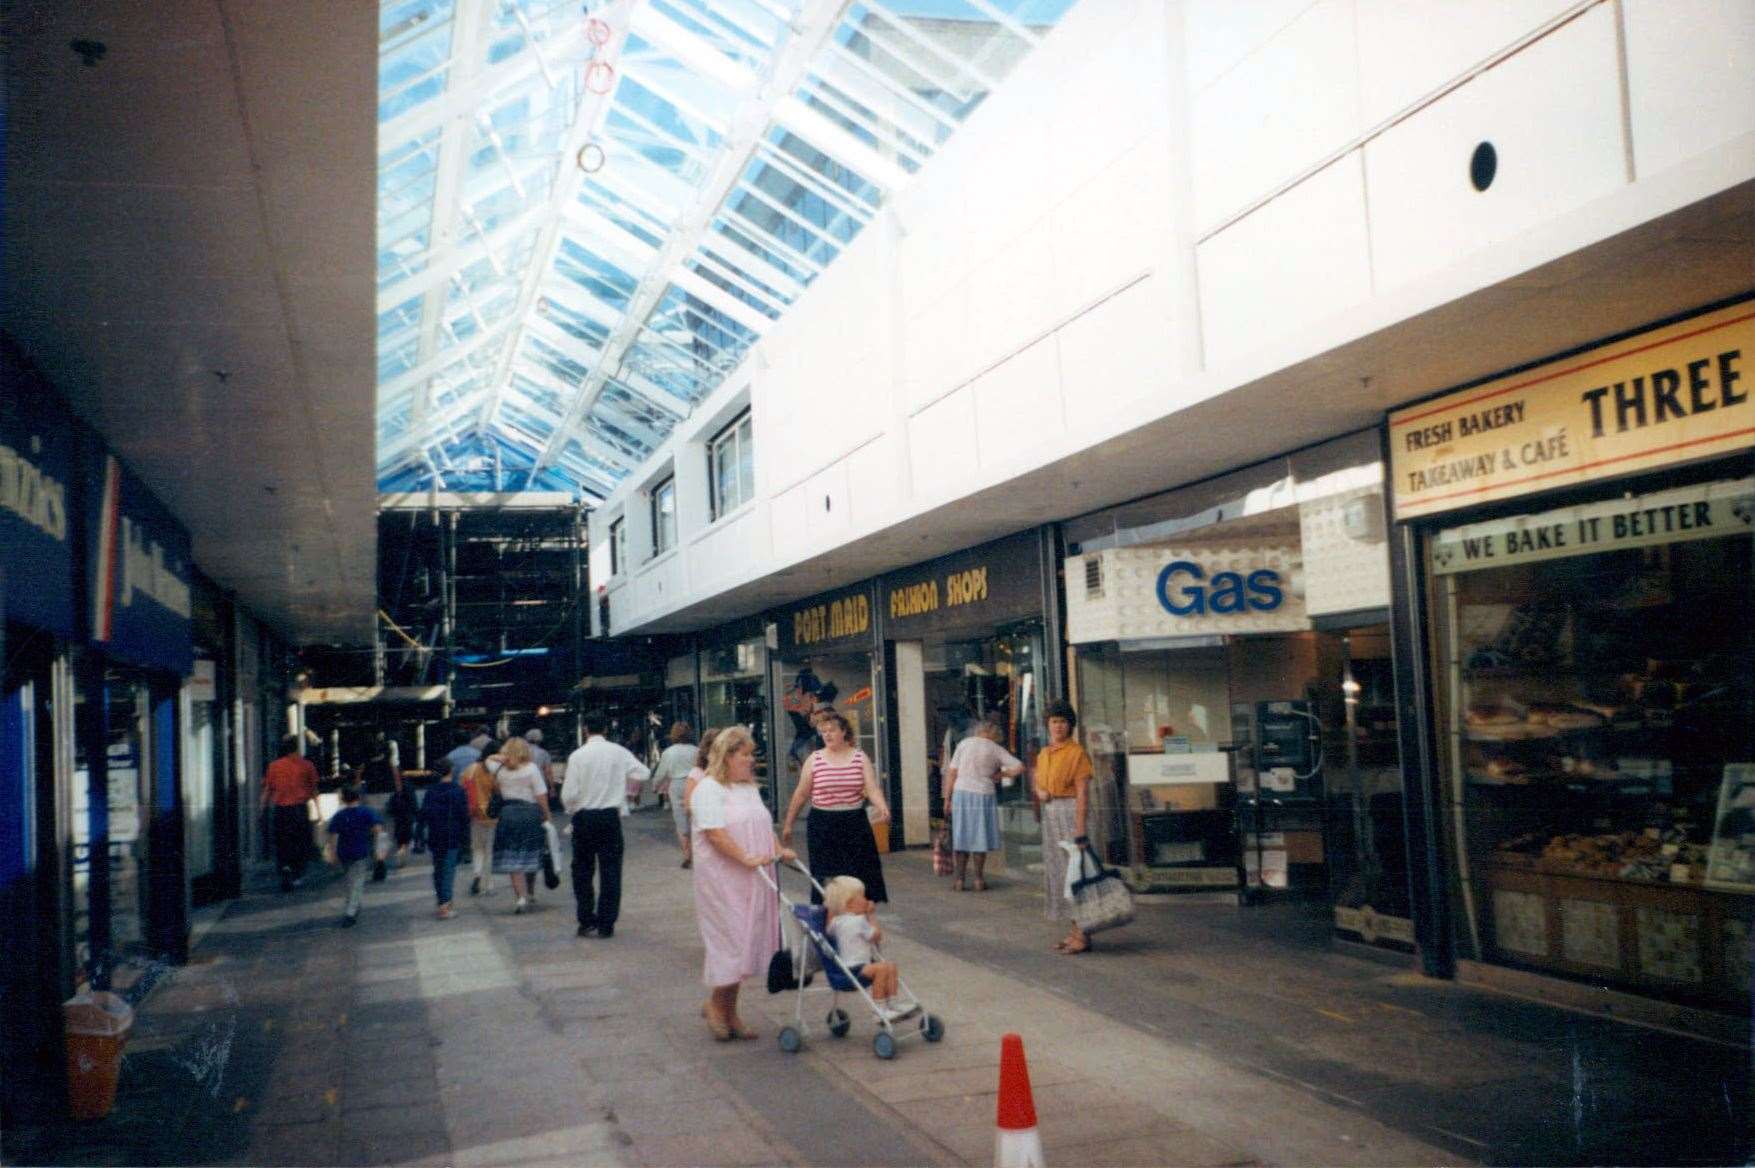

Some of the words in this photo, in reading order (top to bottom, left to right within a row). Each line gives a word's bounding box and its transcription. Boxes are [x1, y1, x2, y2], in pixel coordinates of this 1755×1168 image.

[1582, 350, 1748, 438] THREE
[1405, 420, 1453, 452] FRESH
[1459, 401, 1525, 438] BAKERY
[1408, 455, 1496, 492] TAKEAWAY
[1502, 447, 1517, 470] &
[1520, 428, 1570, 466] CAFÉ
[1463, 535, 1495, 560] WE
[1507, 524, 1566, 554] BAKE
[1579, 516, 1600, 544] IT
[1613, 501, 1713, 539] BETTER
[947, 566, 988, 606] SHOPS
[1156, 560, 1284, 616] Gas
[831, 594, 869, 638] MAID
